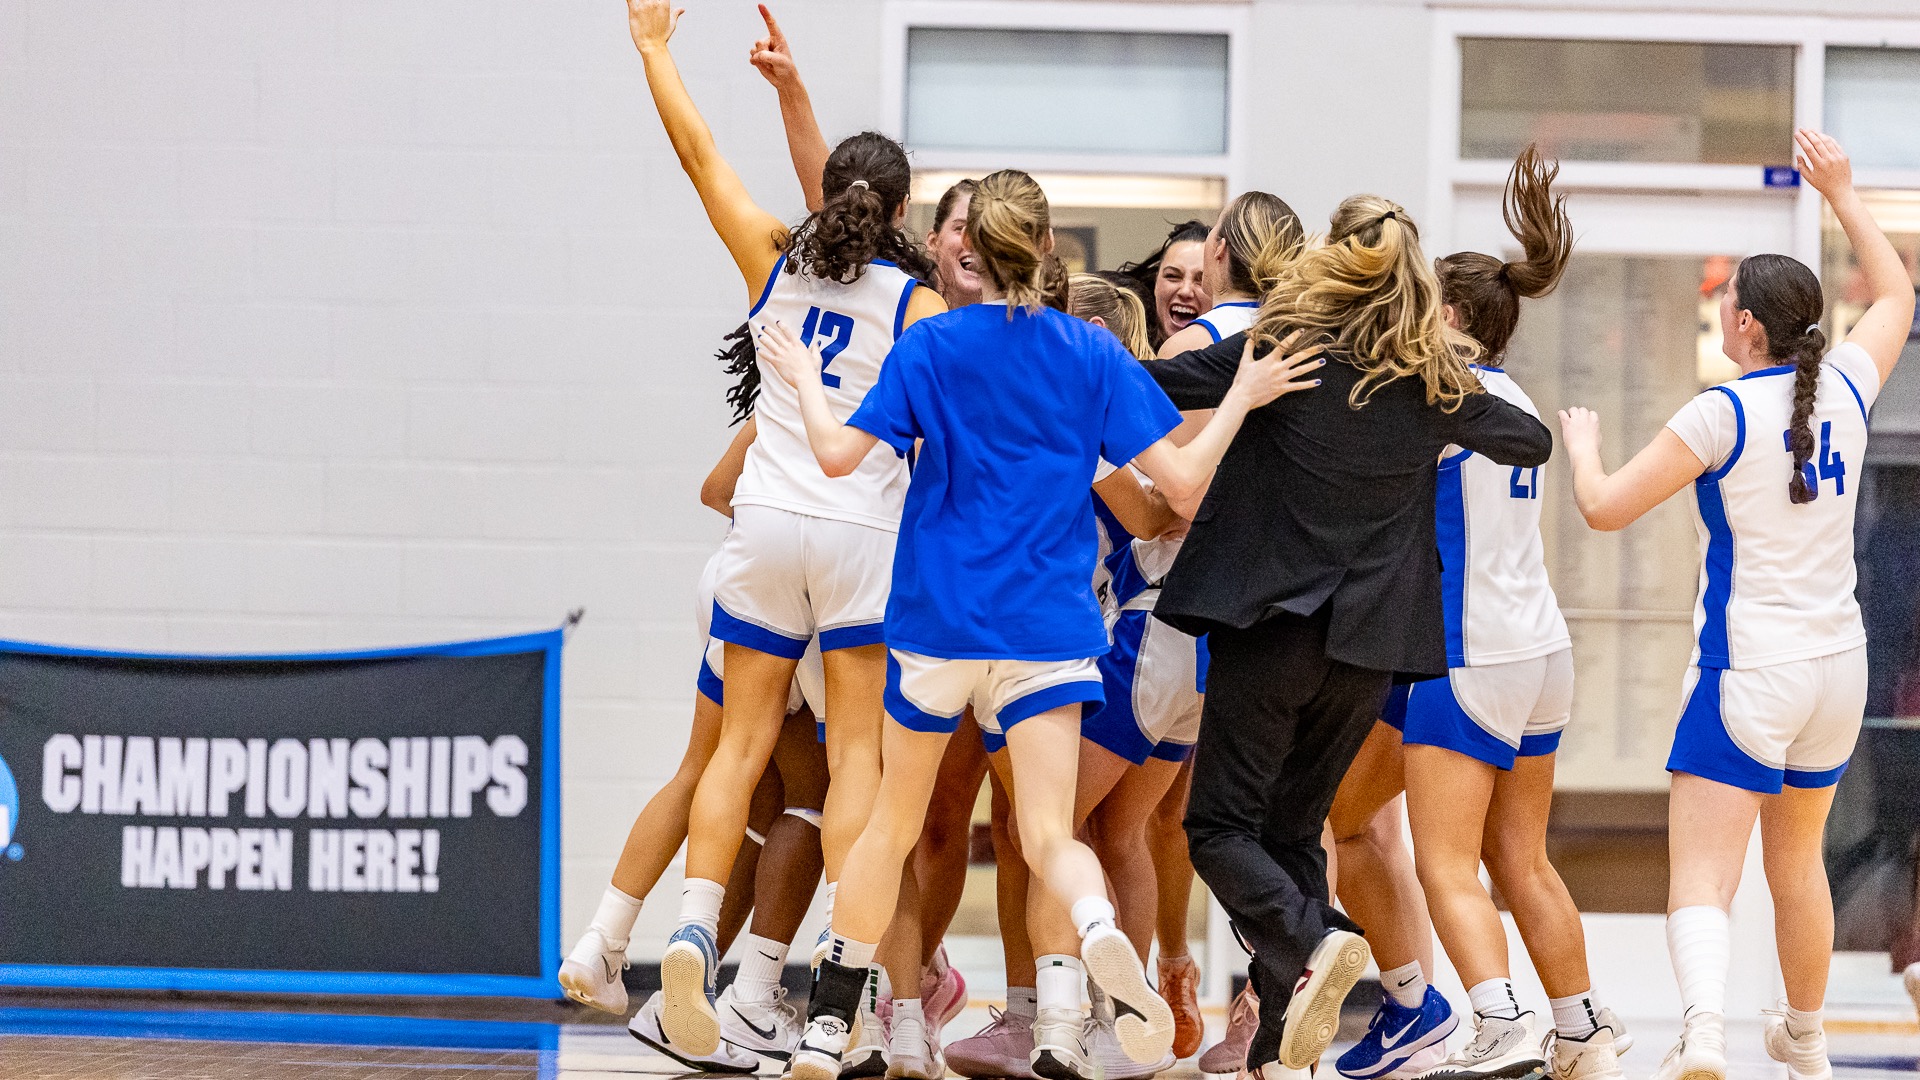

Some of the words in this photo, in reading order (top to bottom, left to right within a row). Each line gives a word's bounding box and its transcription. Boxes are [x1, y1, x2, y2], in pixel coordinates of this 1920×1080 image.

[42, 733, 529, 819] CHAMPIONSHIPS
[121, 825, 293, 891] HAPPEN
[308, 828, 440, 892] HERE!
